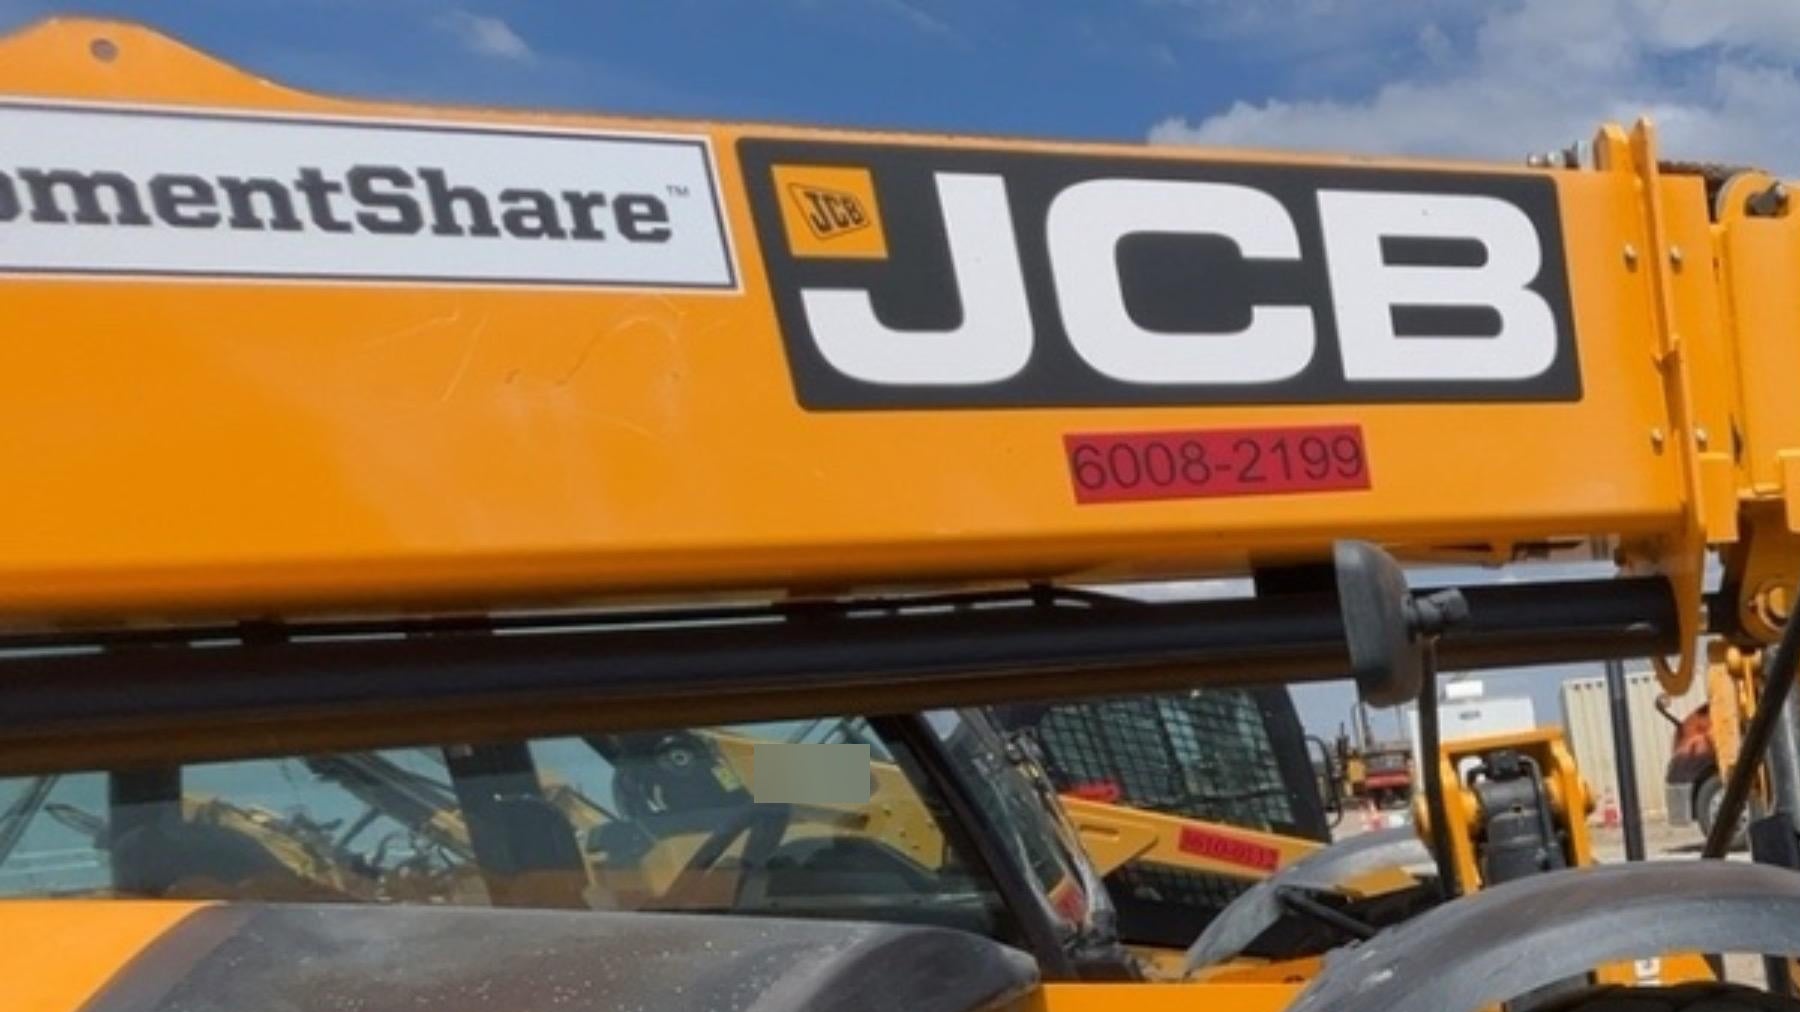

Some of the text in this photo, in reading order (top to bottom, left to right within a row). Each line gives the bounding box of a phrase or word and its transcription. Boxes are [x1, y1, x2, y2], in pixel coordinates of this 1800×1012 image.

[803, 190, 864, 233] JCB
[800, 171, 1559, 385] JCB
[1072, 435, 1363, 491] 6008-2199
